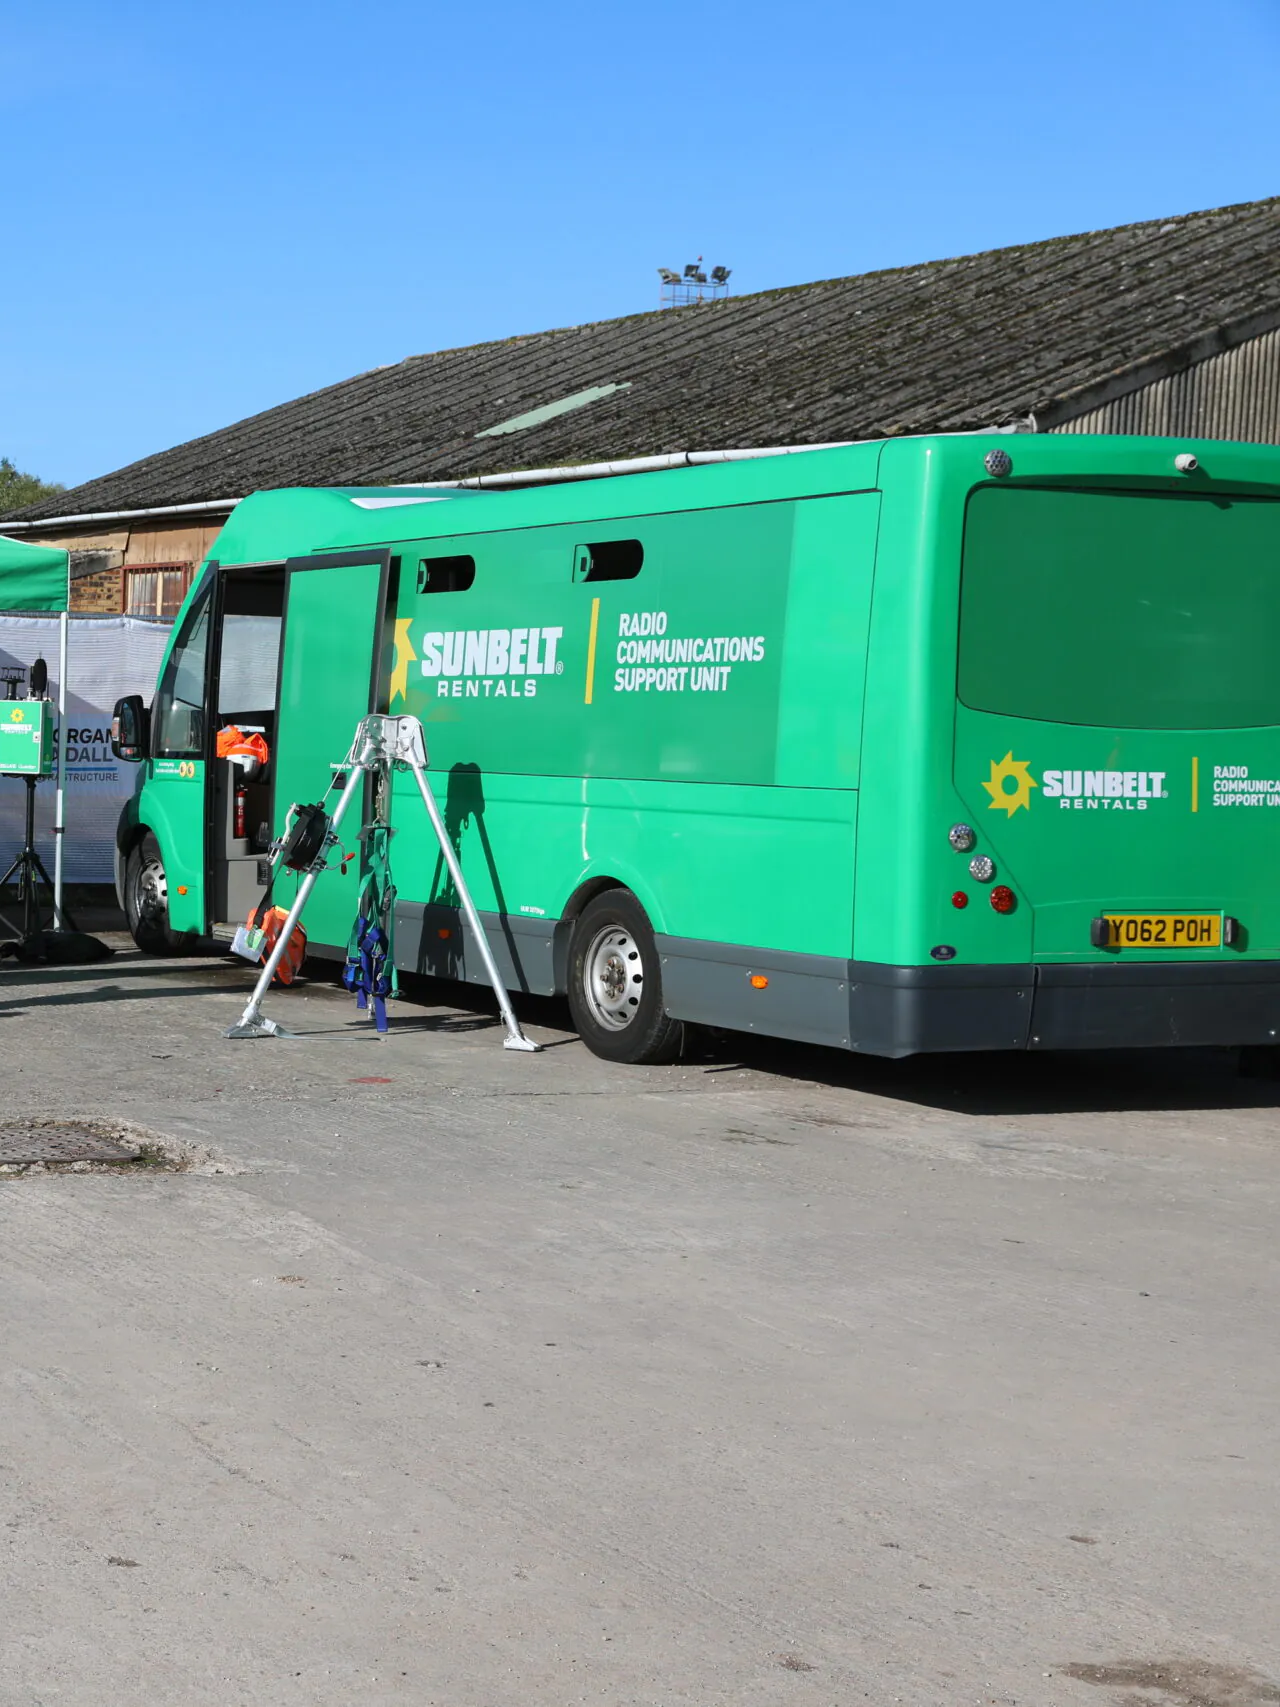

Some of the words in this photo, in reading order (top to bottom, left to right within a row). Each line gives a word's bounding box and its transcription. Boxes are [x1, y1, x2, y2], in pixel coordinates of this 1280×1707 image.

[618, 611, 667, 637] RADIO
[616, 636, 765, 665] COMMUNICATIONS
[437, 679, 537, 698] RENTALS
[614, 667, 688, 693] SUPPORT
[690, 666, 732, 692] UNIT
[1213, 766, 1249, 779] RADIO
[1059, 799, 1148, 810] RENTALS
[1212, 793, 1266, 807] SUPPORT
[1111, 919, 1167, 942] YO62
[1172, 919, 1212, 942] POH
